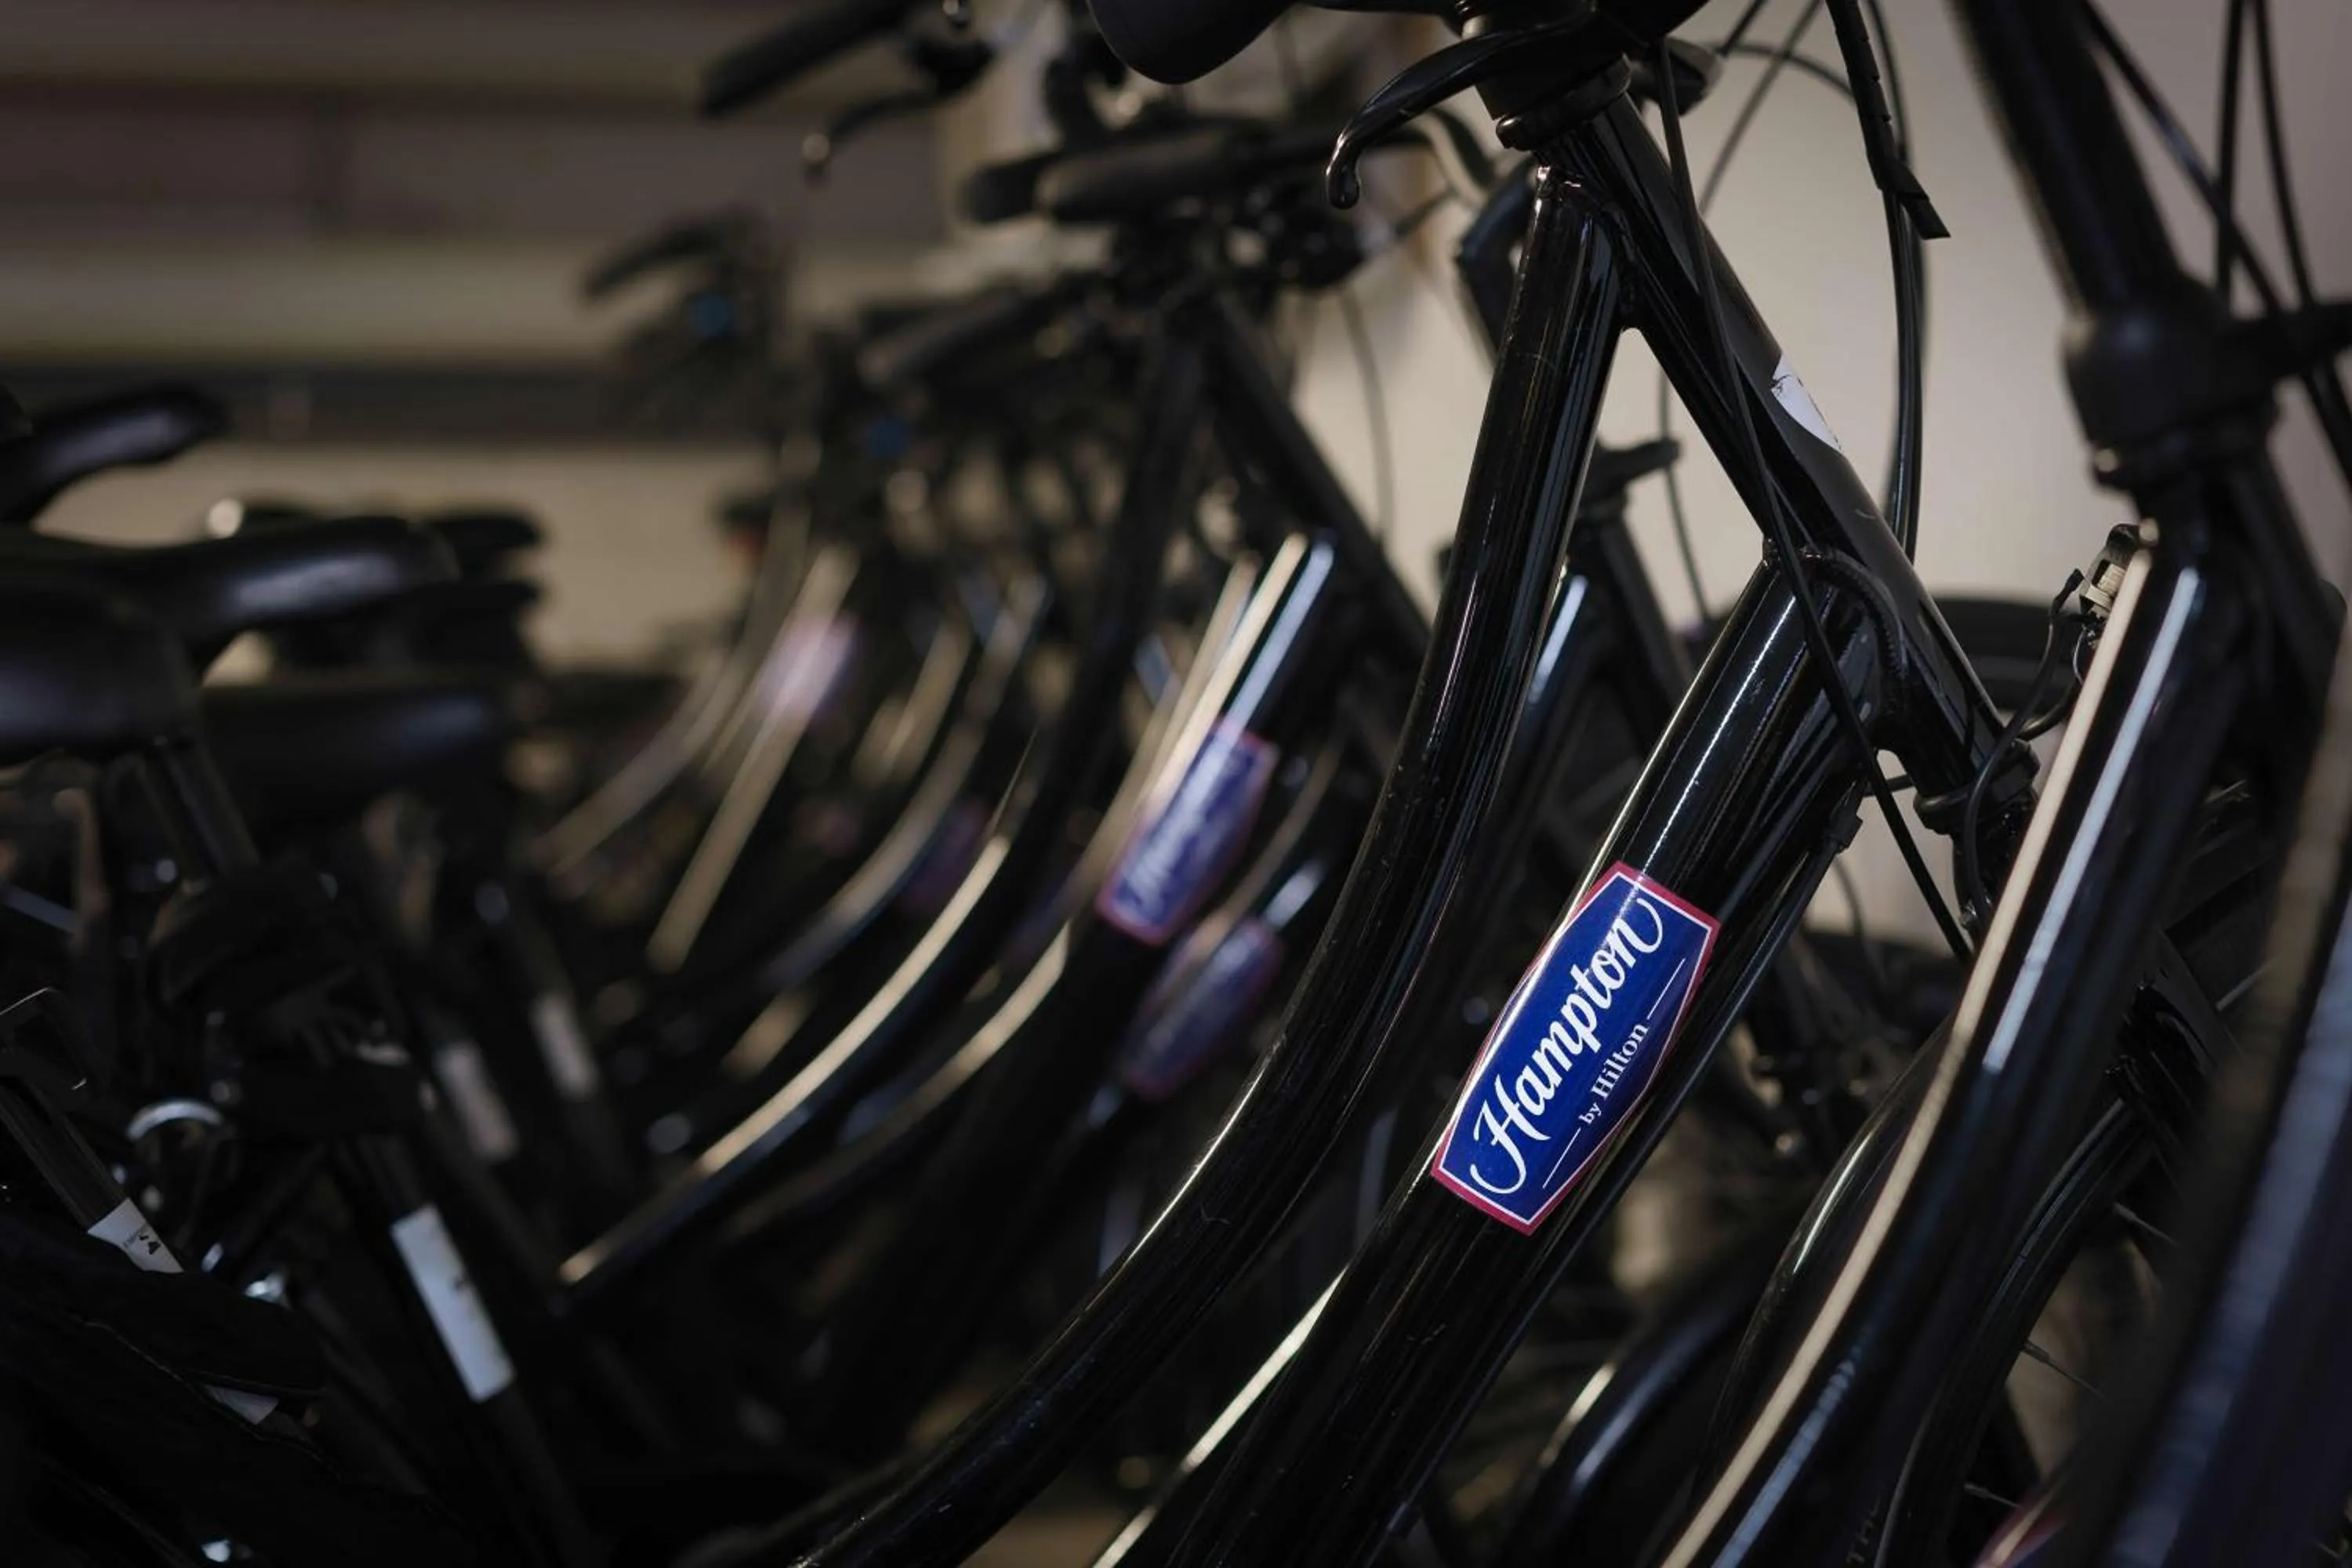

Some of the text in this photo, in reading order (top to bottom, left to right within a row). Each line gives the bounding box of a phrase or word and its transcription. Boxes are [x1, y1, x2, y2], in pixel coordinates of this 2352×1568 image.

[1469, 897, 1663, 1194] Hampton
[1578, 1023, 1649, 1124] by Hilton
